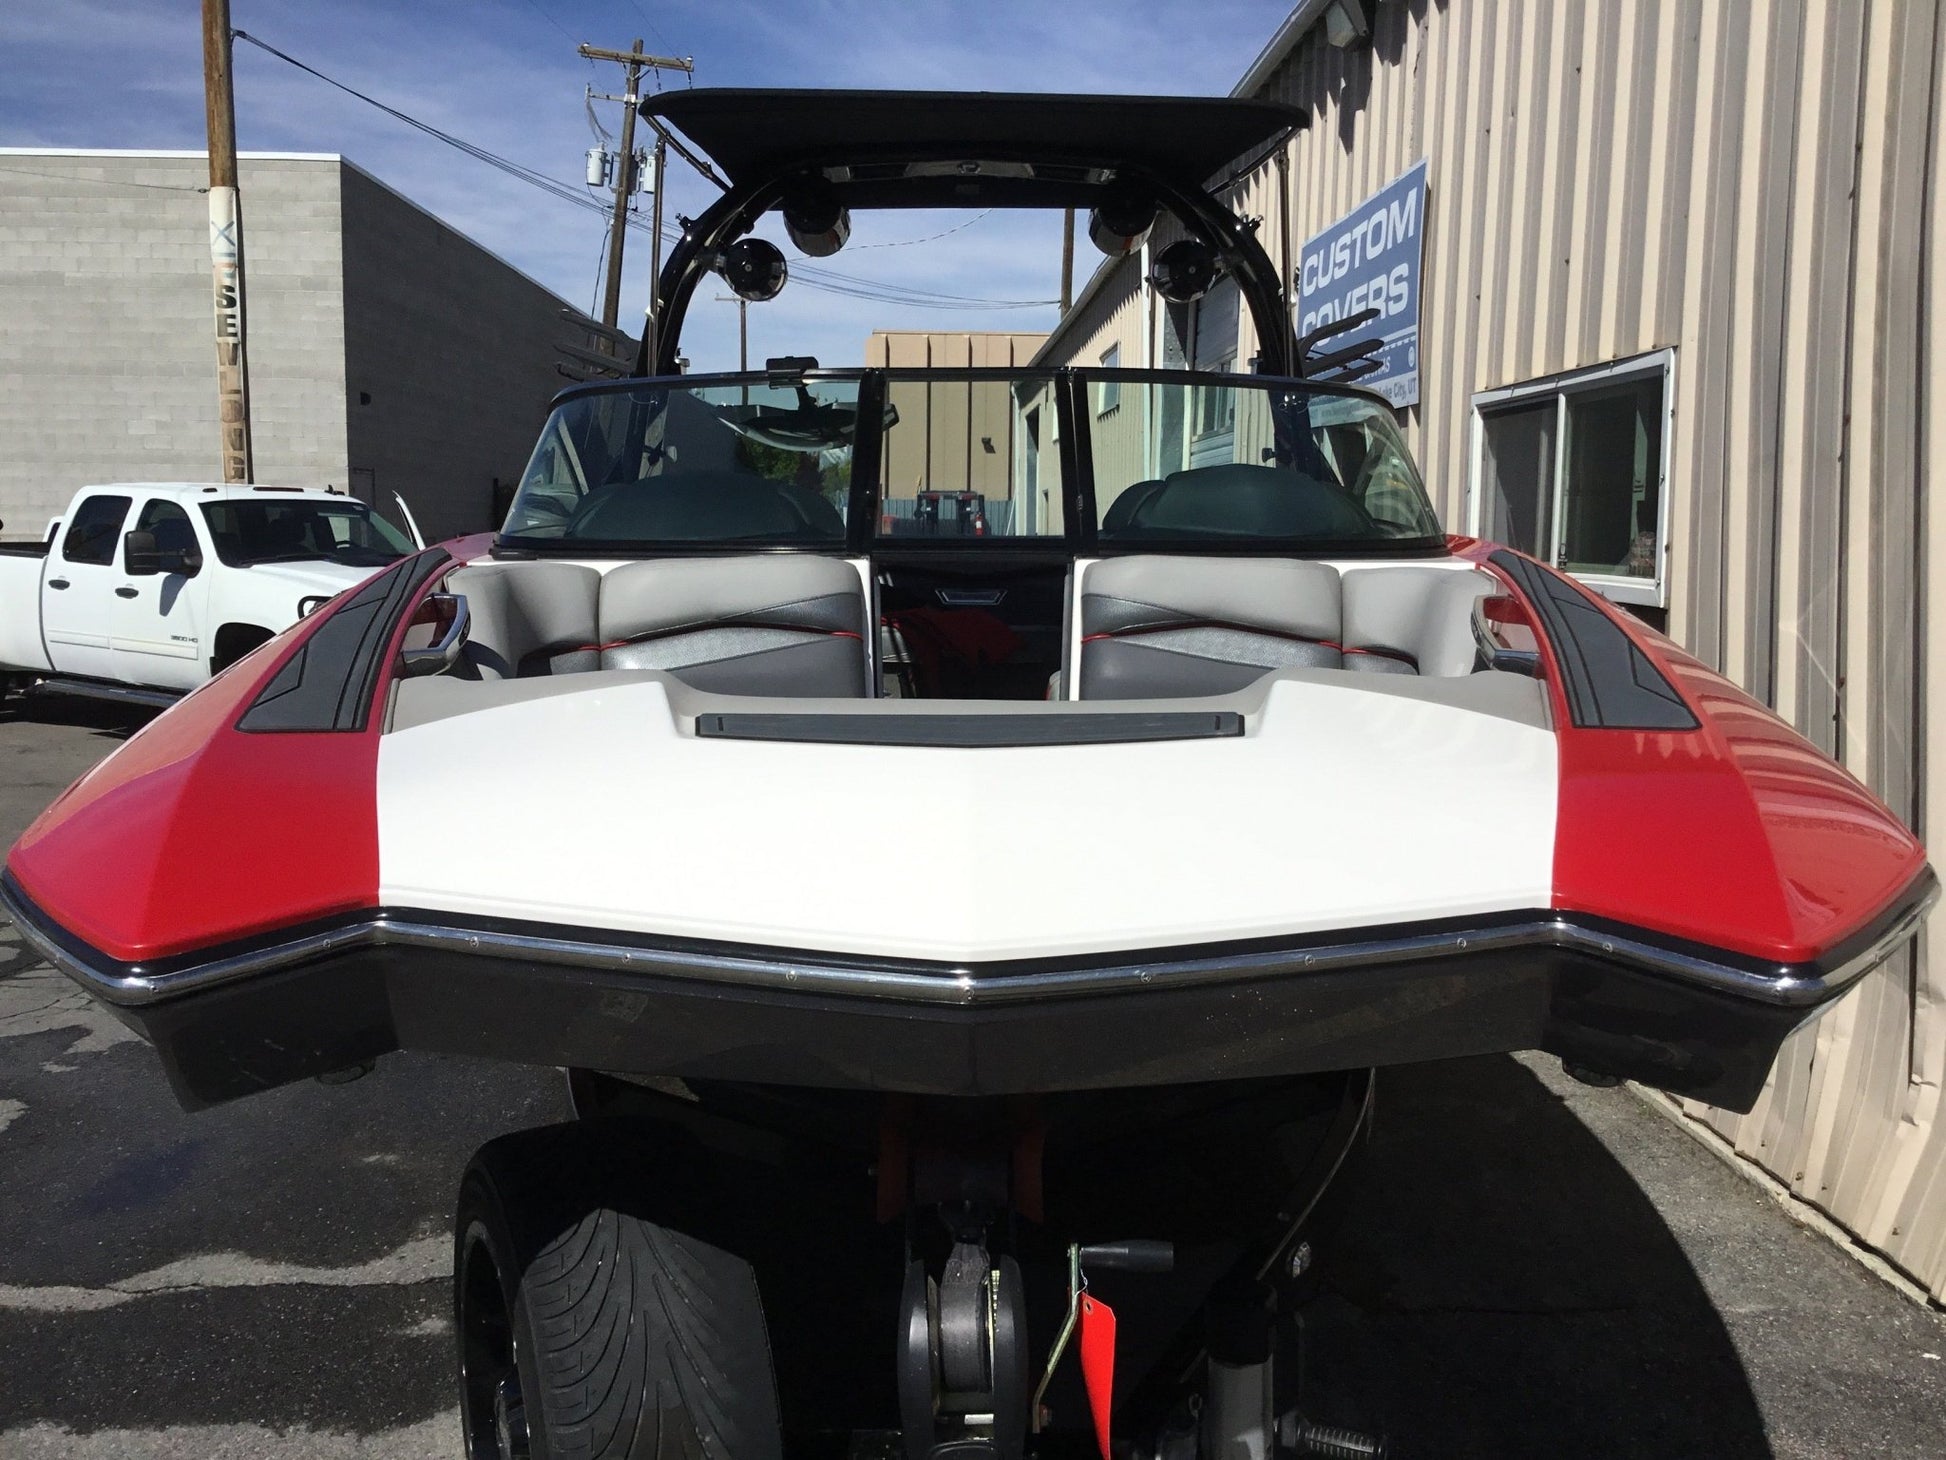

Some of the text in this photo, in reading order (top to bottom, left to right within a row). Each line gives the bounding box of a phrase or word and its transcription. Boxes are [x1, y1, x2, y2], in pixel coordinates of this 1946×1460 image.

[1303, 187, 1418, 298] CUSTOM
[1302, 262, 1410, 347] COVERS
[1408, 376, 1417, 394] UT
